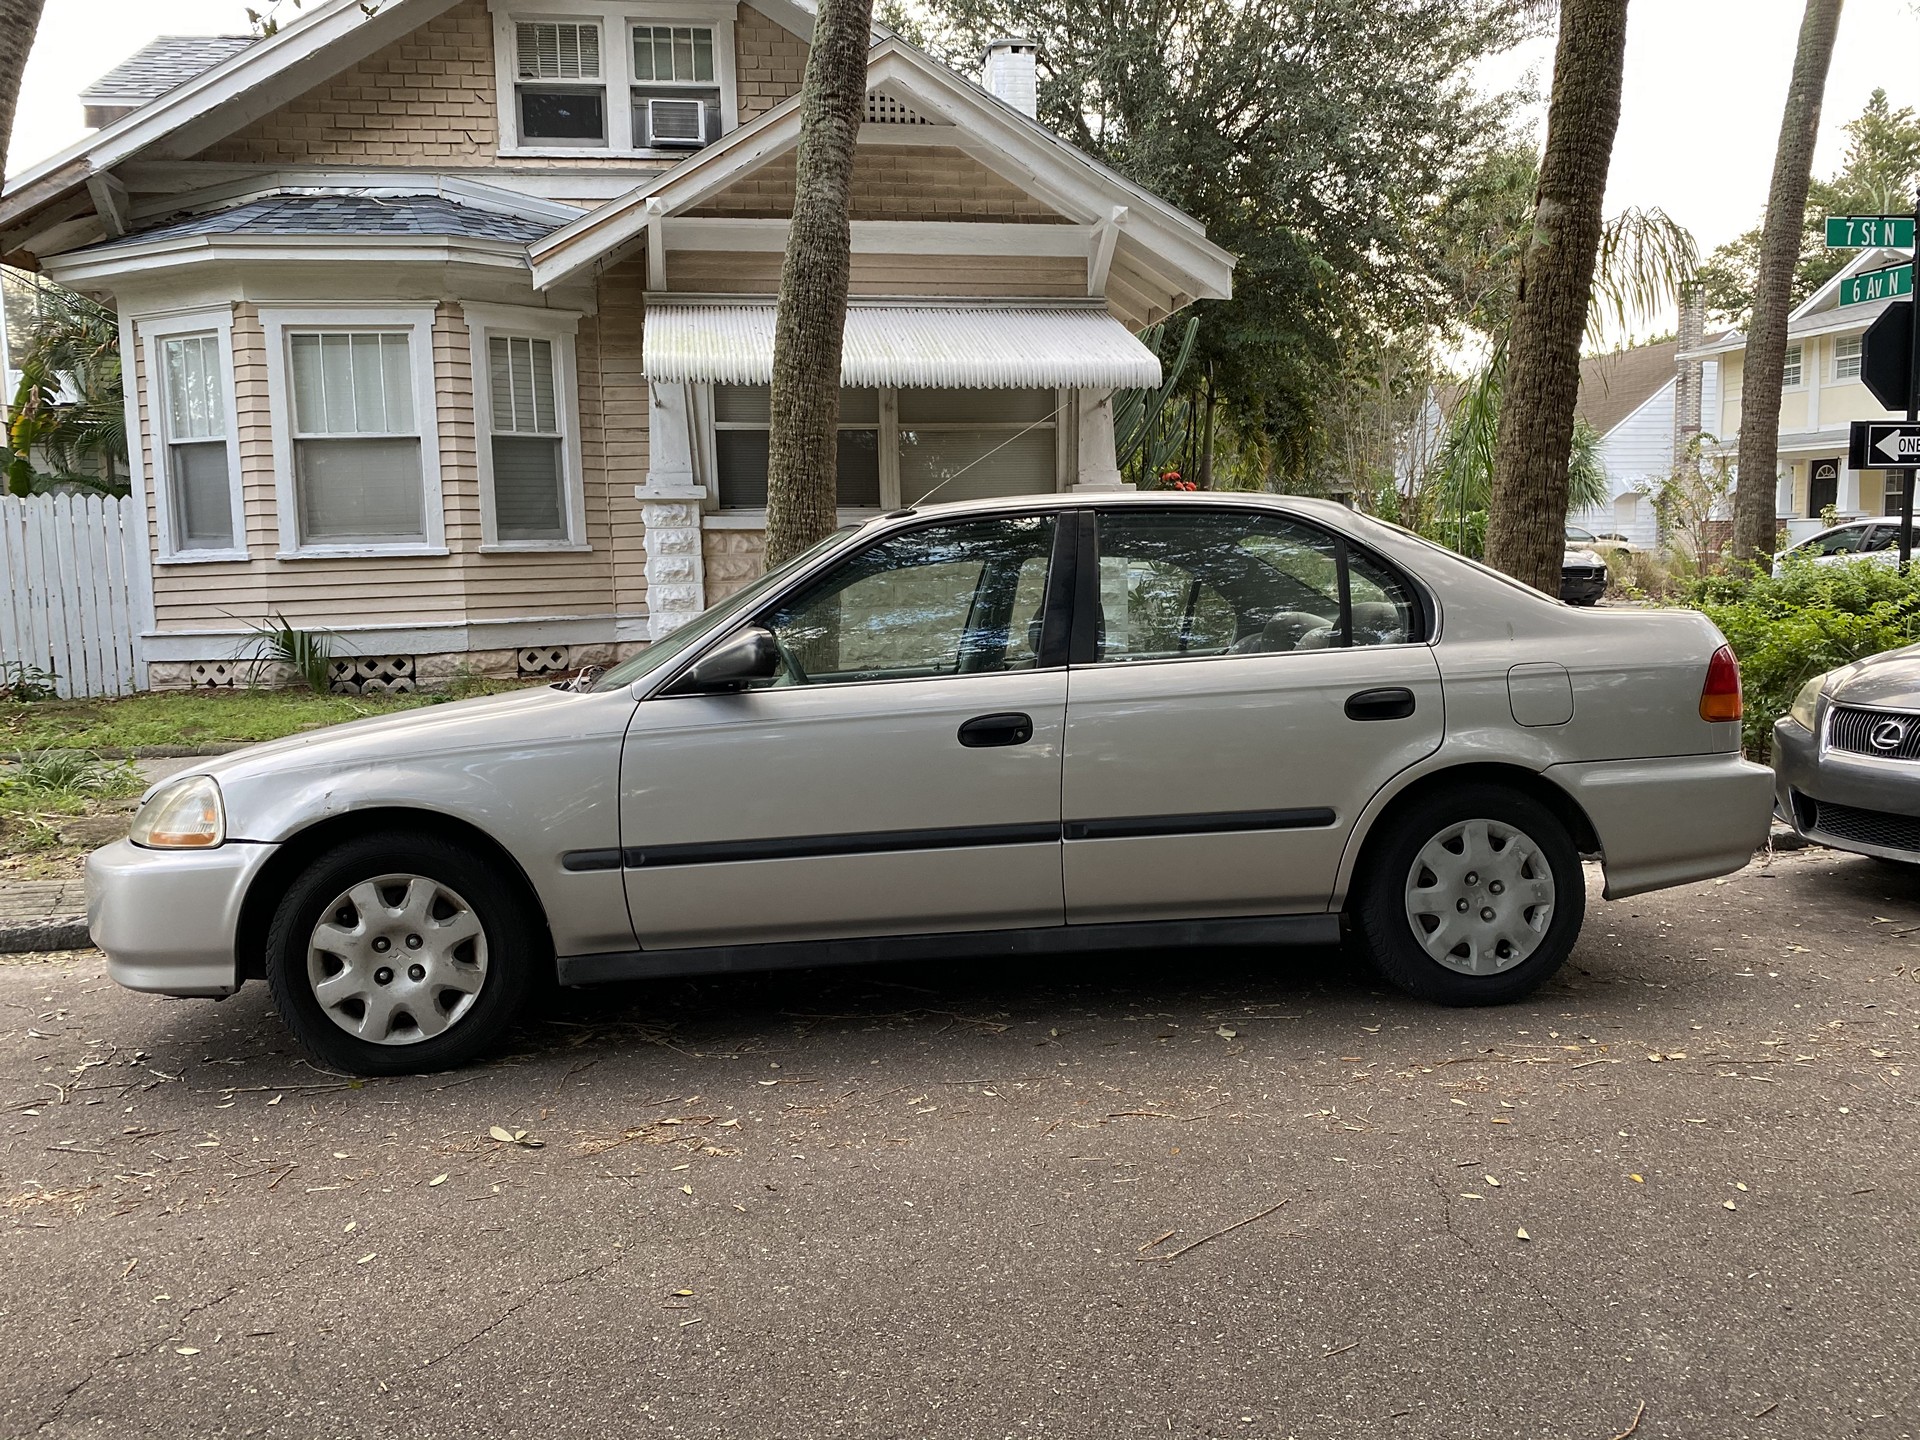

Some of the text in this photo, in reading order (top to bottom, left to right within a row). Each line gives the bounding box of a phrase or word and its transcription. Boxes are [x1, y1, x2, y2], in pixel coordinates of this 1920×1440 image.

[1846, 222, 1895, 246] 7 St N
[1853, 271, 1898, 302] 6 Av N
